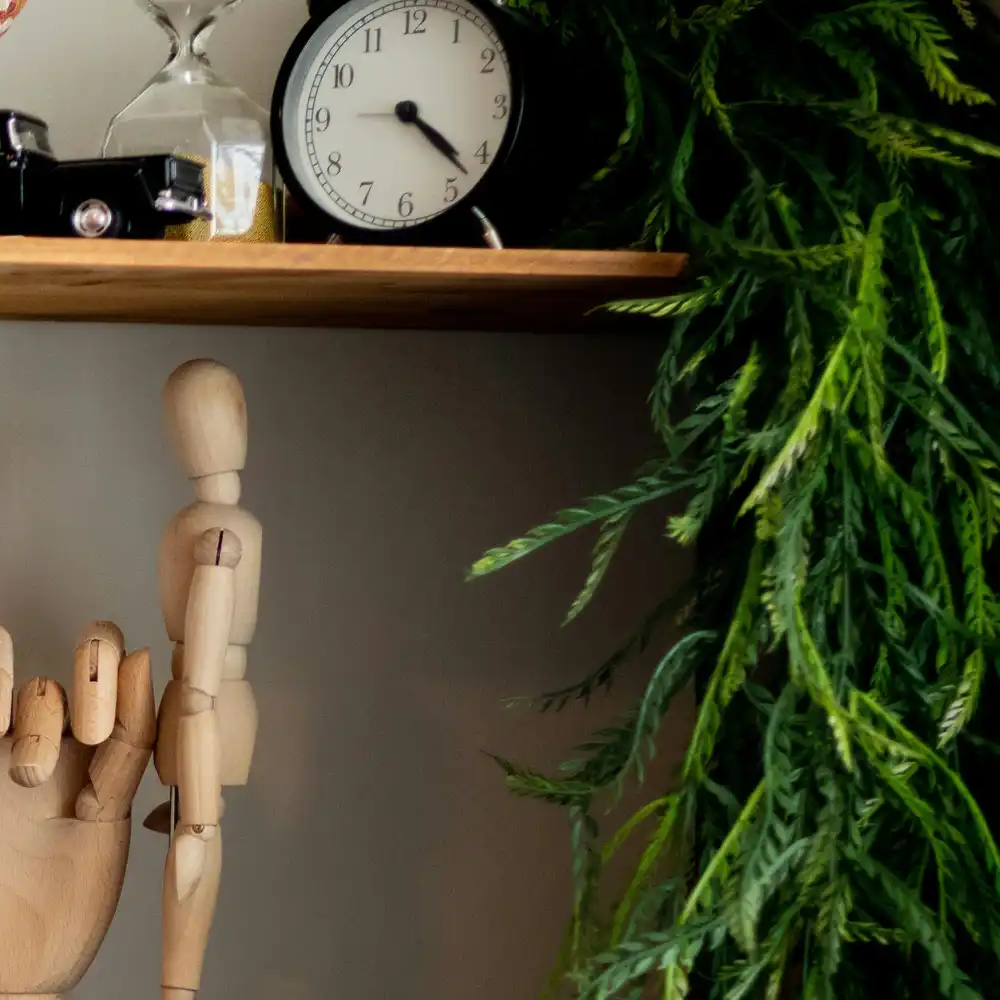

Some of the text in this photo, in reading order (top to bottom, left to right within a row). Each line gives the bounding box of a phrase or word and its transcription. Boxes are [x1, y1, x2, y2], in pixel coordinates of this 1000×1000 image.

[403, 9, 428, 35] 12
[451, 18, 460, 44] 1
[363, 27, 382, 53] 11
[480, 48, 496, 74] 2
[332, 62, 354, 89] 10
[315, 107, 331, 132] 9
[492, 94, 508, 120] 3
[326, 151, 342, 176] 8
[474, 140, 491, 165] 4
[359, 181, 374, 206] 7
[444, 177, 458, 203] 5
[397, 192, 414, 218] 6
